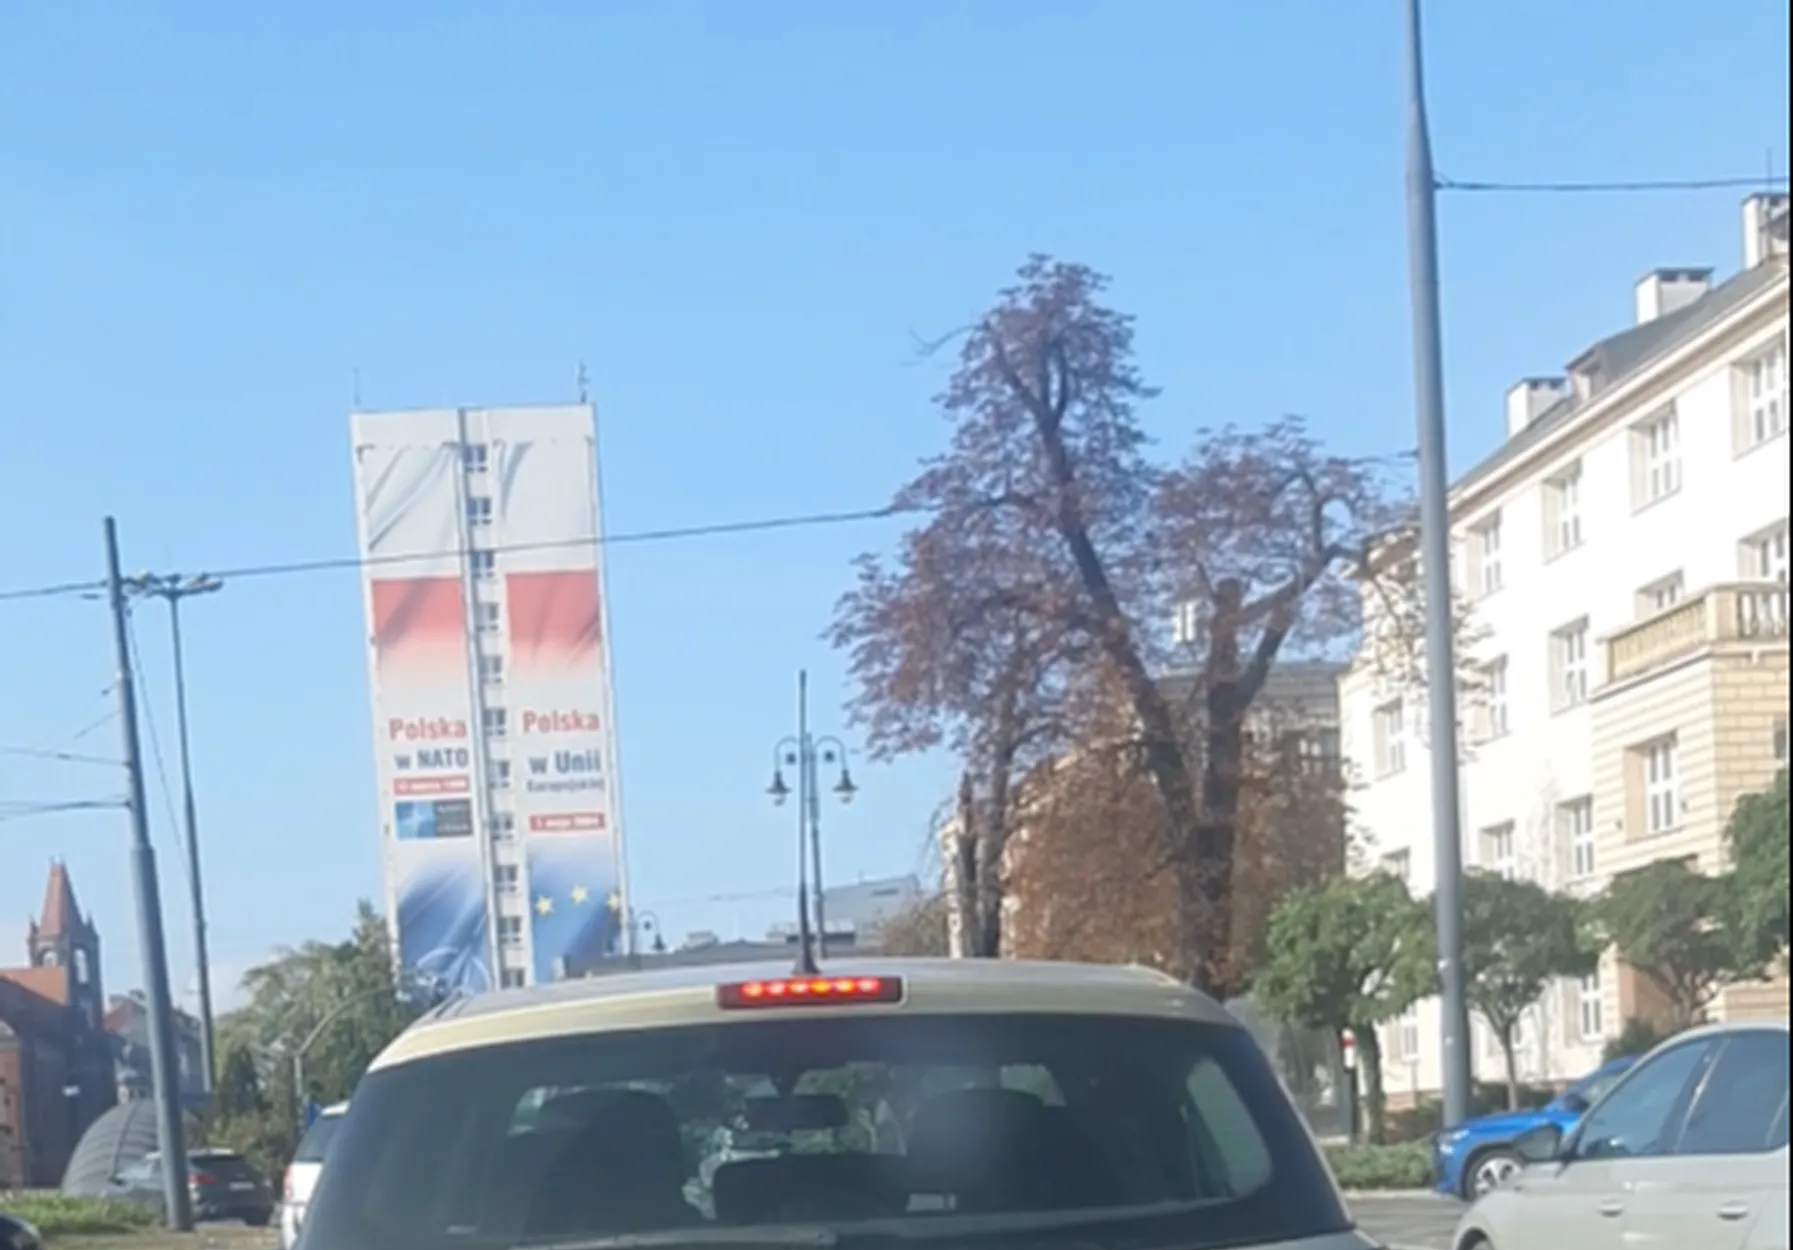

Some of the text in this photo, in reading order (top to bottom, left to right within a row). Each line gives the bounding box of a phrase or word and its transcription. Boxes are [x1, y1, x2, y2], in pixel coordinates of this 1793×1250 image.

[389, 718, 467, 740] Polska
[523, 710, 600, 733] Polska
[394, 748, 469, 769] w NATO
[528, 750, 602, 774] w Unii
